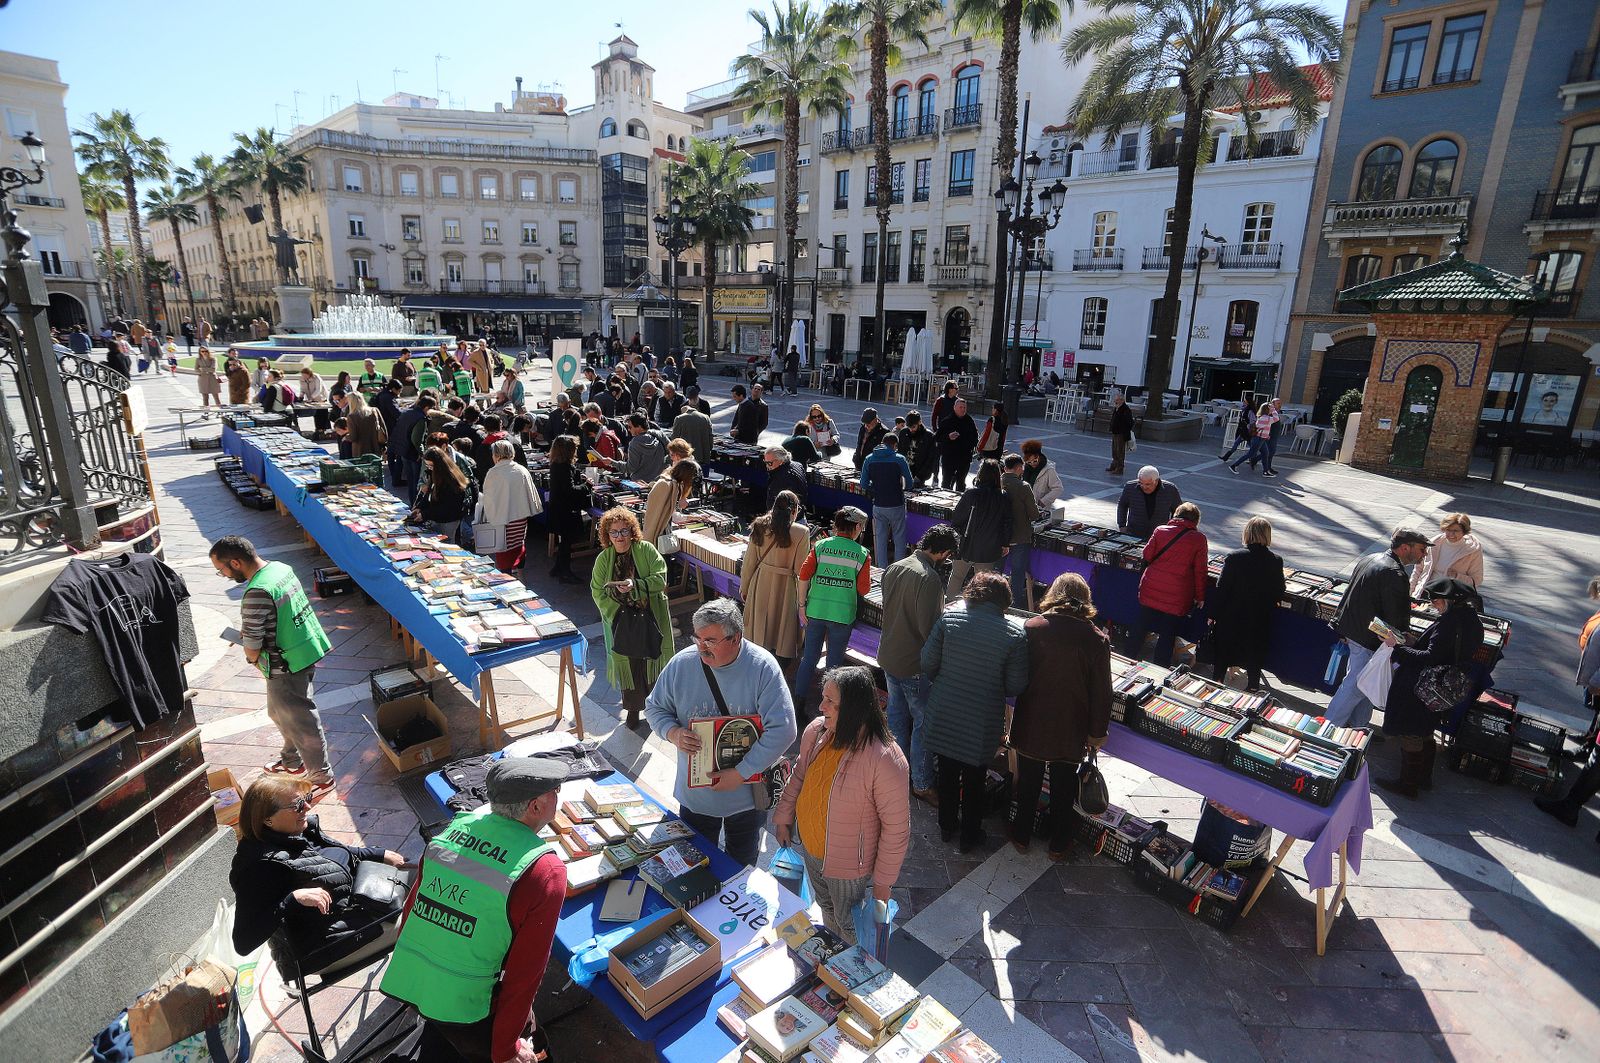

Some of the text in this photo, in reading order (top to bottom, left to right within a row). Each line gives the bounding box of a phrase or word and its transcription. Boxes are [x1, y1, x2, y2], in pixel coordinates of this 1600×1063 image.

[821, 547, 860, 559] VOLUNTEER
[816, 577, 853, 588] SOLIDARIO
[446, 828, 509, 864] MEDICAL
[426, 876, 470, 905] AYRE
[413, 900, 475, 936] SOLIDARIO
[719, 890, 769, 931] ayre
